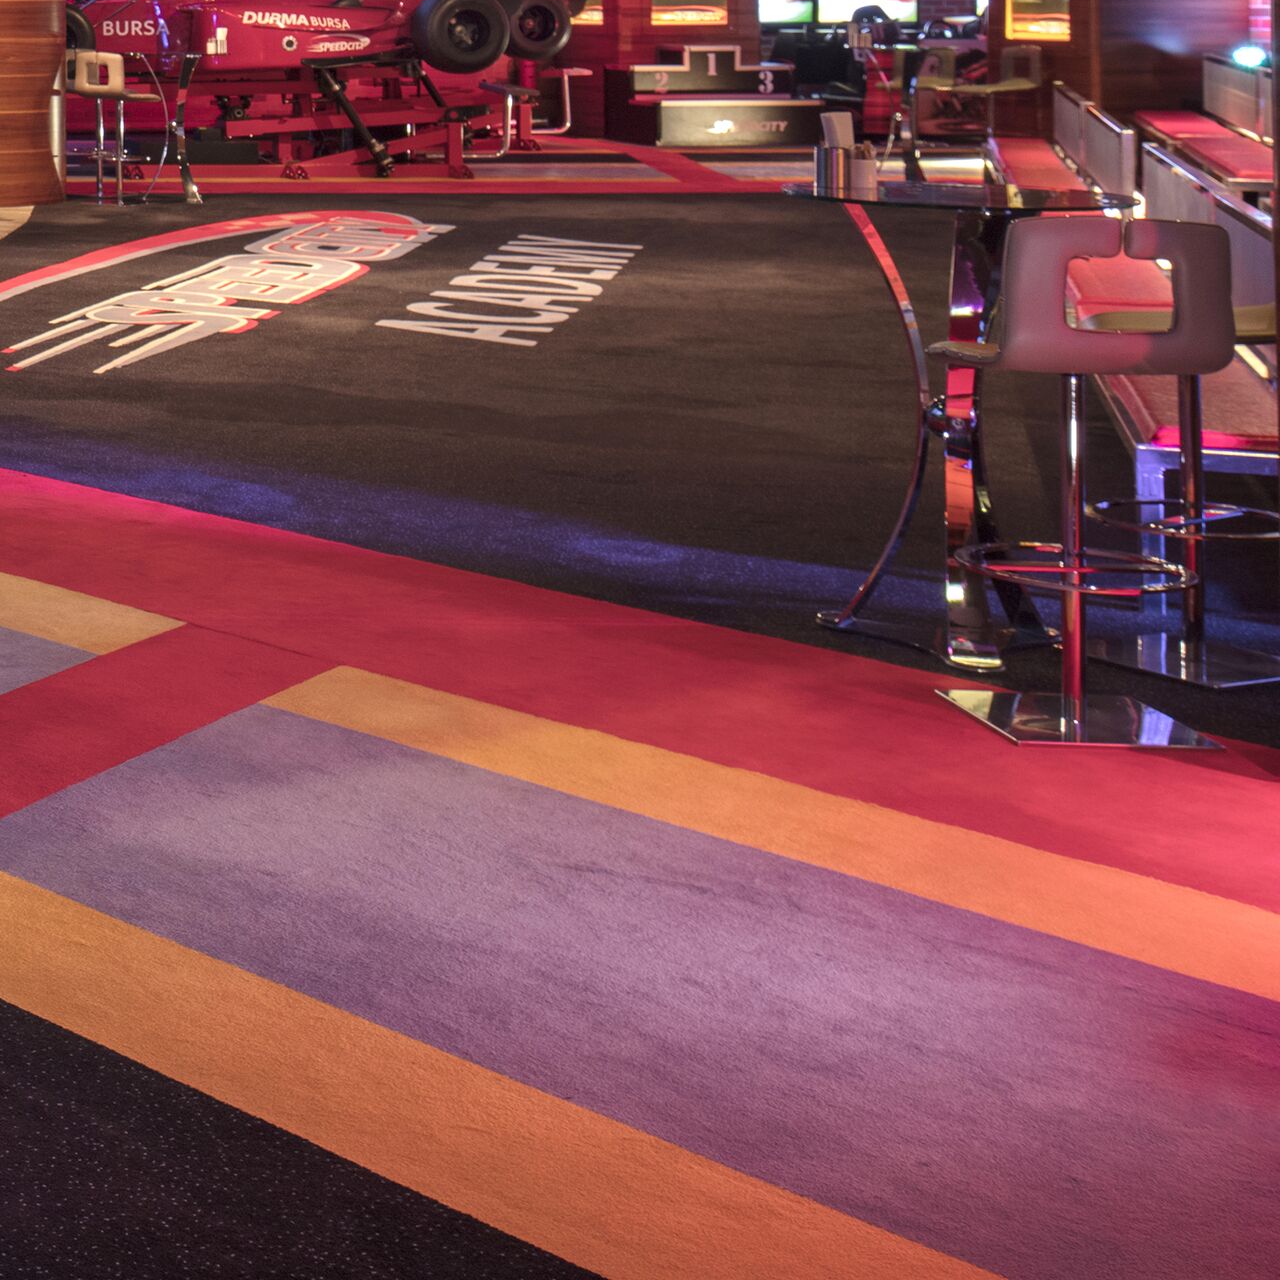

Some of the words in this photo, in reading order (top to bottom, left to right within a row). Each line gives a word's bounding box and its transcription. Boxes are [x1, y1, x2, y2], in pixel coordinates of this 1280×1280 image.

[102, 19, 170, 36] BURSA
[242, 10, 309, 26] DURMA
[310, 15, 351, 29] BURSA
[706, 52, 718, 76] 1
[654, 71, 669, 94] 2
[758, 70, 774, 94] 3
[375, 234, 644, 347] ACADEMY
